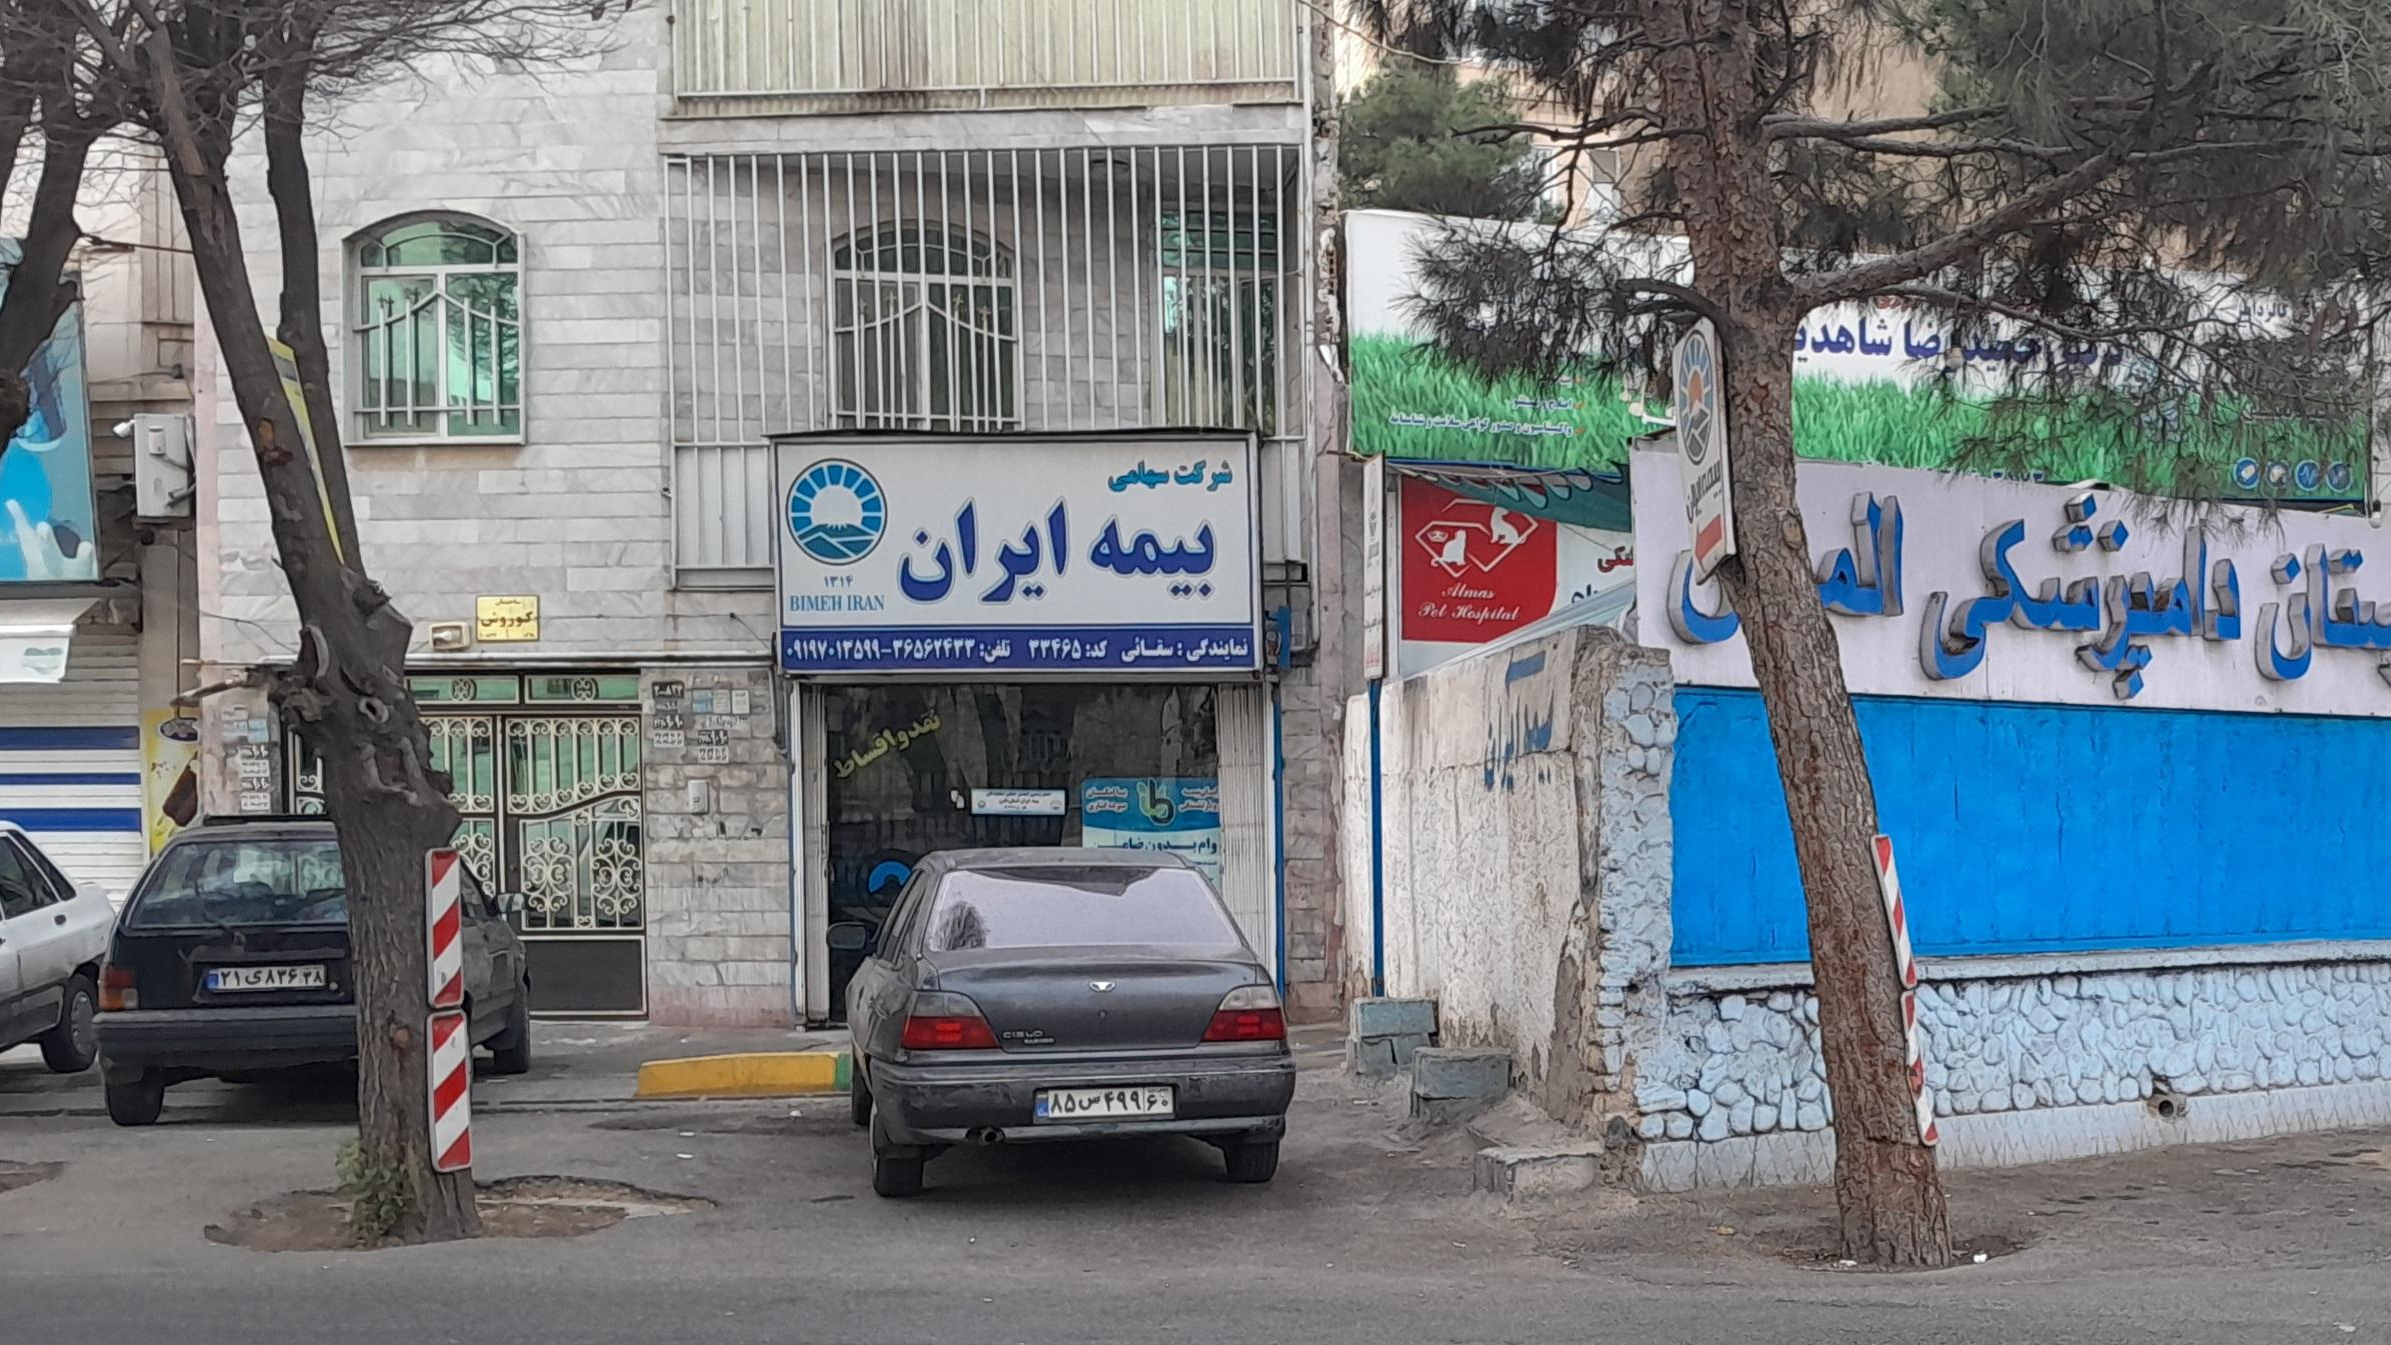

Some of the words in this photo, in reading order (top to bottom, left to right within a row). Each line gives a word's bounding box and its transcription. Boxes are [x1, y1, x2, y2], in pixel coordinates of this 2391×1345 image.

[1108, 460, 1170, 492] سهامی
[1174, 460, 1233, 491] شرکت
[898, 498, 1068, 603] ایران
[1091, 516, 1215, 599] بیمه
[824, 575, 853, 588] ۱۳۱۴
[1441, 582, 1495, 599] Almas
[790, 595, 842, 611] BIMEH
[847, 595, 885, 611] IRAN
[1920, 493, 2241, 699] دامپزشکی
[480, 611, 533, 627] کوروش
[1418, 602, 1445, 617] Pet
[1451, 604, 1520, 624] Hospital
[1028, 639, 1082, 660] ۳۳۴۶۵
[1198, 837, 1217, 854] وام
